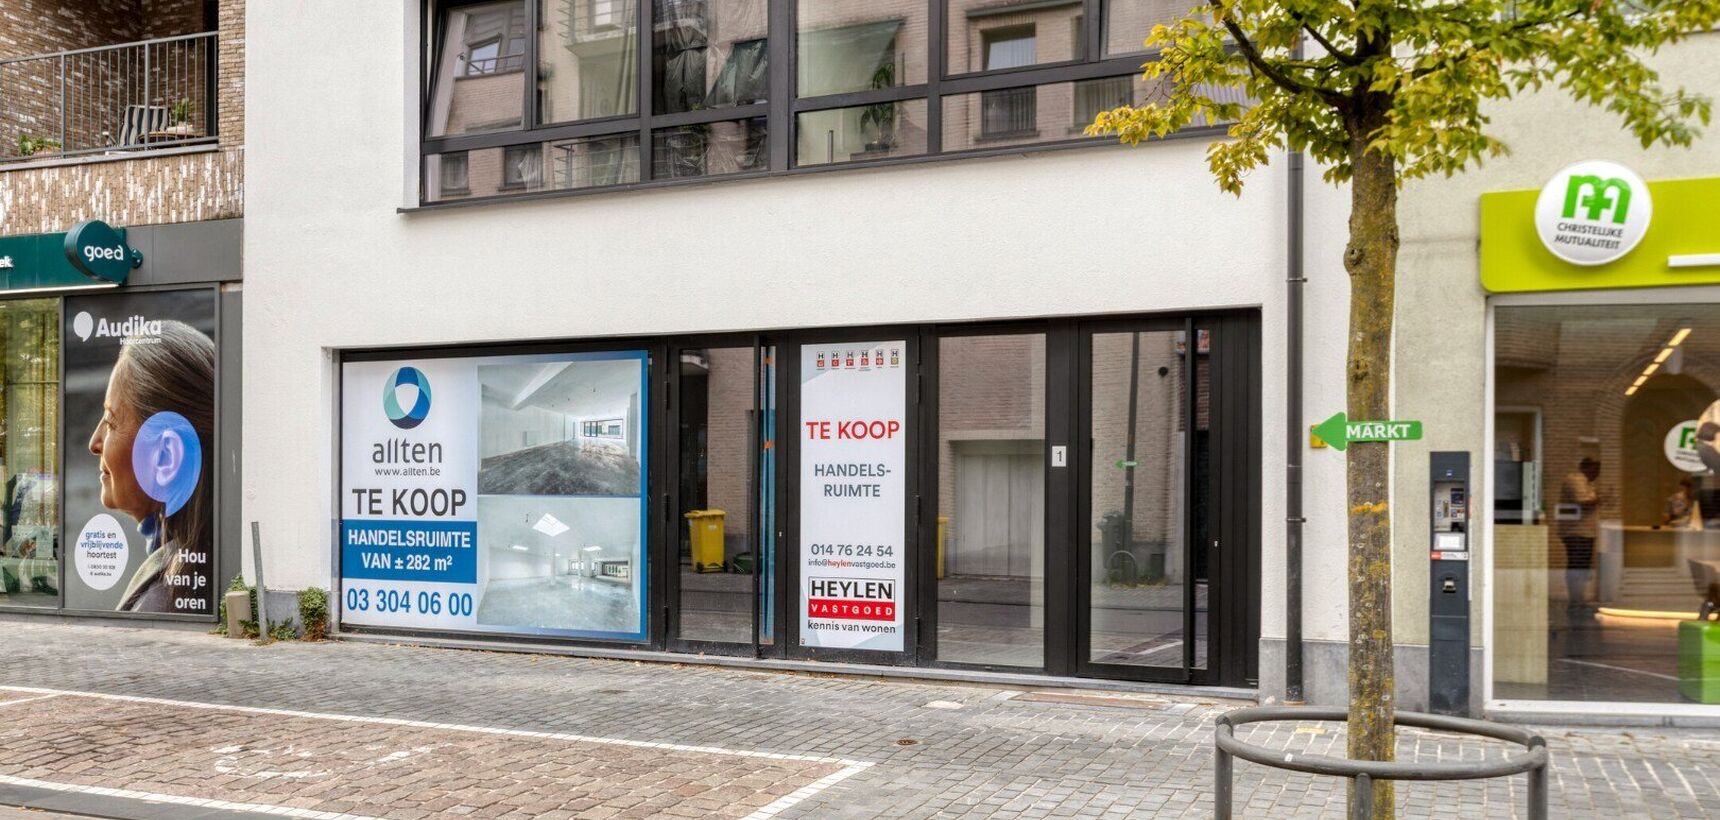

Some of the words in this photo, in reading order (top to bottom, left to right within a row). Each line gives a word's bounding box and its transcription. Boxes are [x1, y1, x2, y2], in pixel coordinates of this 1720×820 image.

[1557, 222, 1624, 238] CHRISTELIJKE
[1554, 234, 1621, 250] MUTUALITEIT
[83, 244, 124, 262] goed
[95, 315, 162, 337] Audika
[119, 336, 162, 345] Hoorcentrum
[805, 421, 831, 440] TE
[837, 420, 900, 440] KOOP
[1345, 423, 1411, 439] MARKT
[372, 437, 443, 464] allten
[1056, 450, 1062, 462] 1
[374, 466, 441, 477] www.allten.be
[814, 463, 892, 477] HANDELS-
[823, 483, 881, 498] RUIMTE
[351, 488, 383, 516] TE
[392, 487, 468, 517] KOOP
[85, 530, 106, 541] gratis
[348, 529, 471, 549] HANDELSRUIMTE
[80, 540, 124, 551] vrijblijvende
[811, 543, 834, 556] 014
[837, 544, 853, 557] 76
[856, 545, 873, 557] 24
[876, 545, 894, 558] 54
[86, 551, 117, 560] hoortest
[178, 548, 206, 564] Hou
[361, 552, 392, 570] VAN
[406, 554, 431, 571] 282
[808, 559, 896, 569] info@heylenvastgoed.be
[166, 574, 190, 586] van
[192, 571, 207, 590] je
[811, 580, 892, 599] HEYLEN
[175, 597, 206, 610] oren
[347, 587, 370, 612] 03
[376, 588, 412, 613] 304
[418, 590, 441, 615] 06
[447, 592, 473, 617] 00
[811, 603, 893, 616] VASTGOED
[807, 620, 840, 631] kennis
[841, 623, 860, 633] van
[861, 625, 896, 634] wonen
